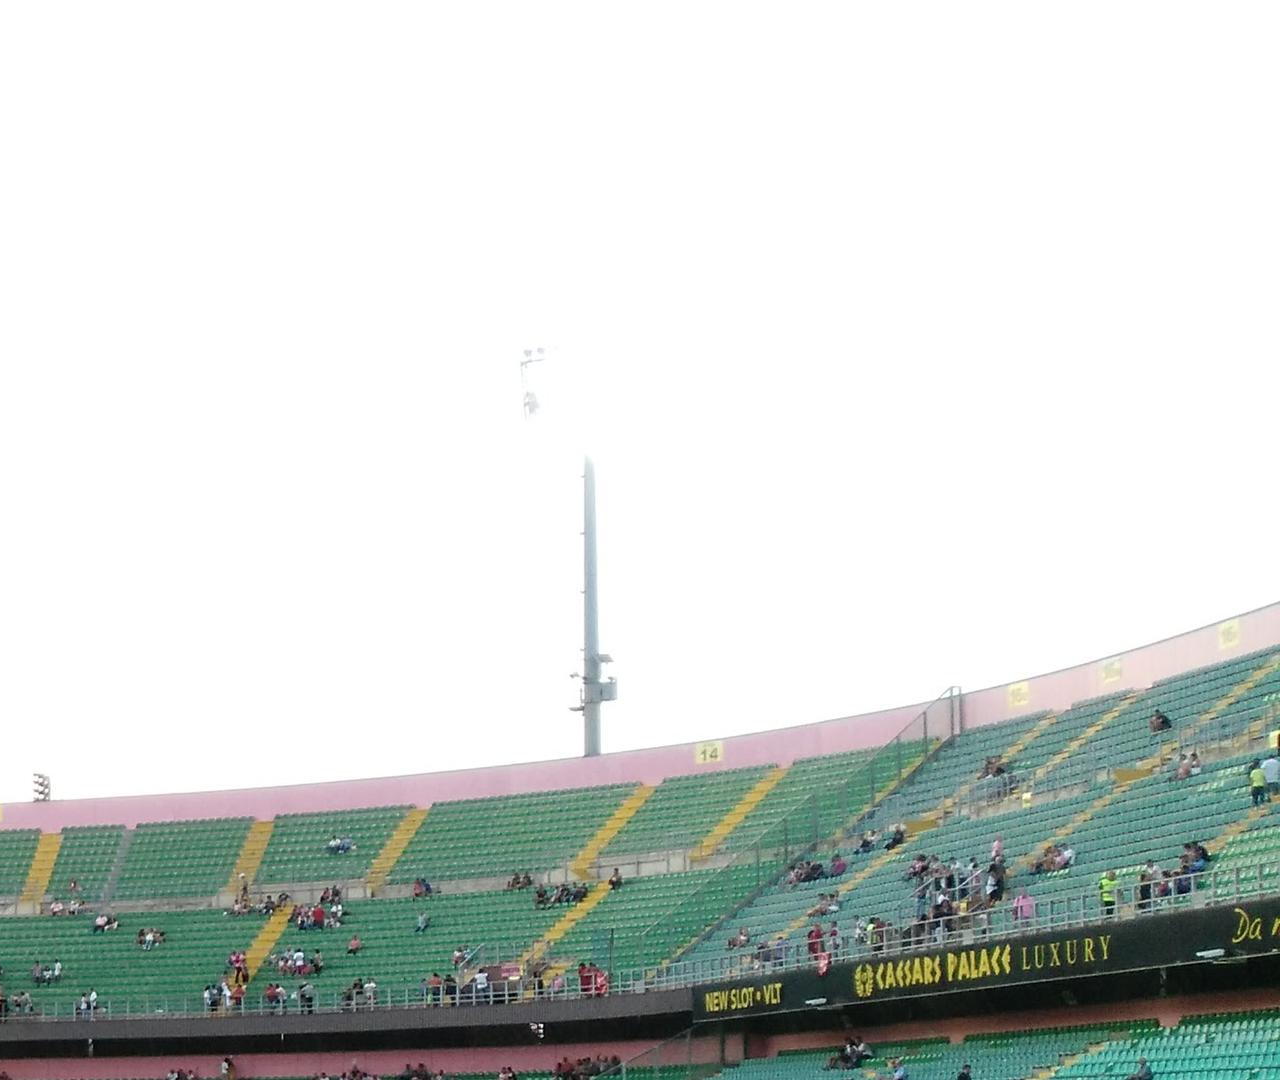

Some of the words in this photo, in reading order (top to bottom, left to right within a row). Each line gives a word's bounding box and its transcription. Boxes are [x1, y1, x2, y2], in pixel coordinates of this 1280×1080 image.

[700, 748, 718, 760] 14
[1232, 907, 1263, 943] Da
[875, 953, 942, 992] CAESARS
[946, 943, 1012, 983] PALACE
[1022, 934, 1112, 971] LUXURY
[705, 990, 728, 1013] NEW
[730, 987, 756, 1011] SLOT
[763, 983, 783, 1005] VLT
